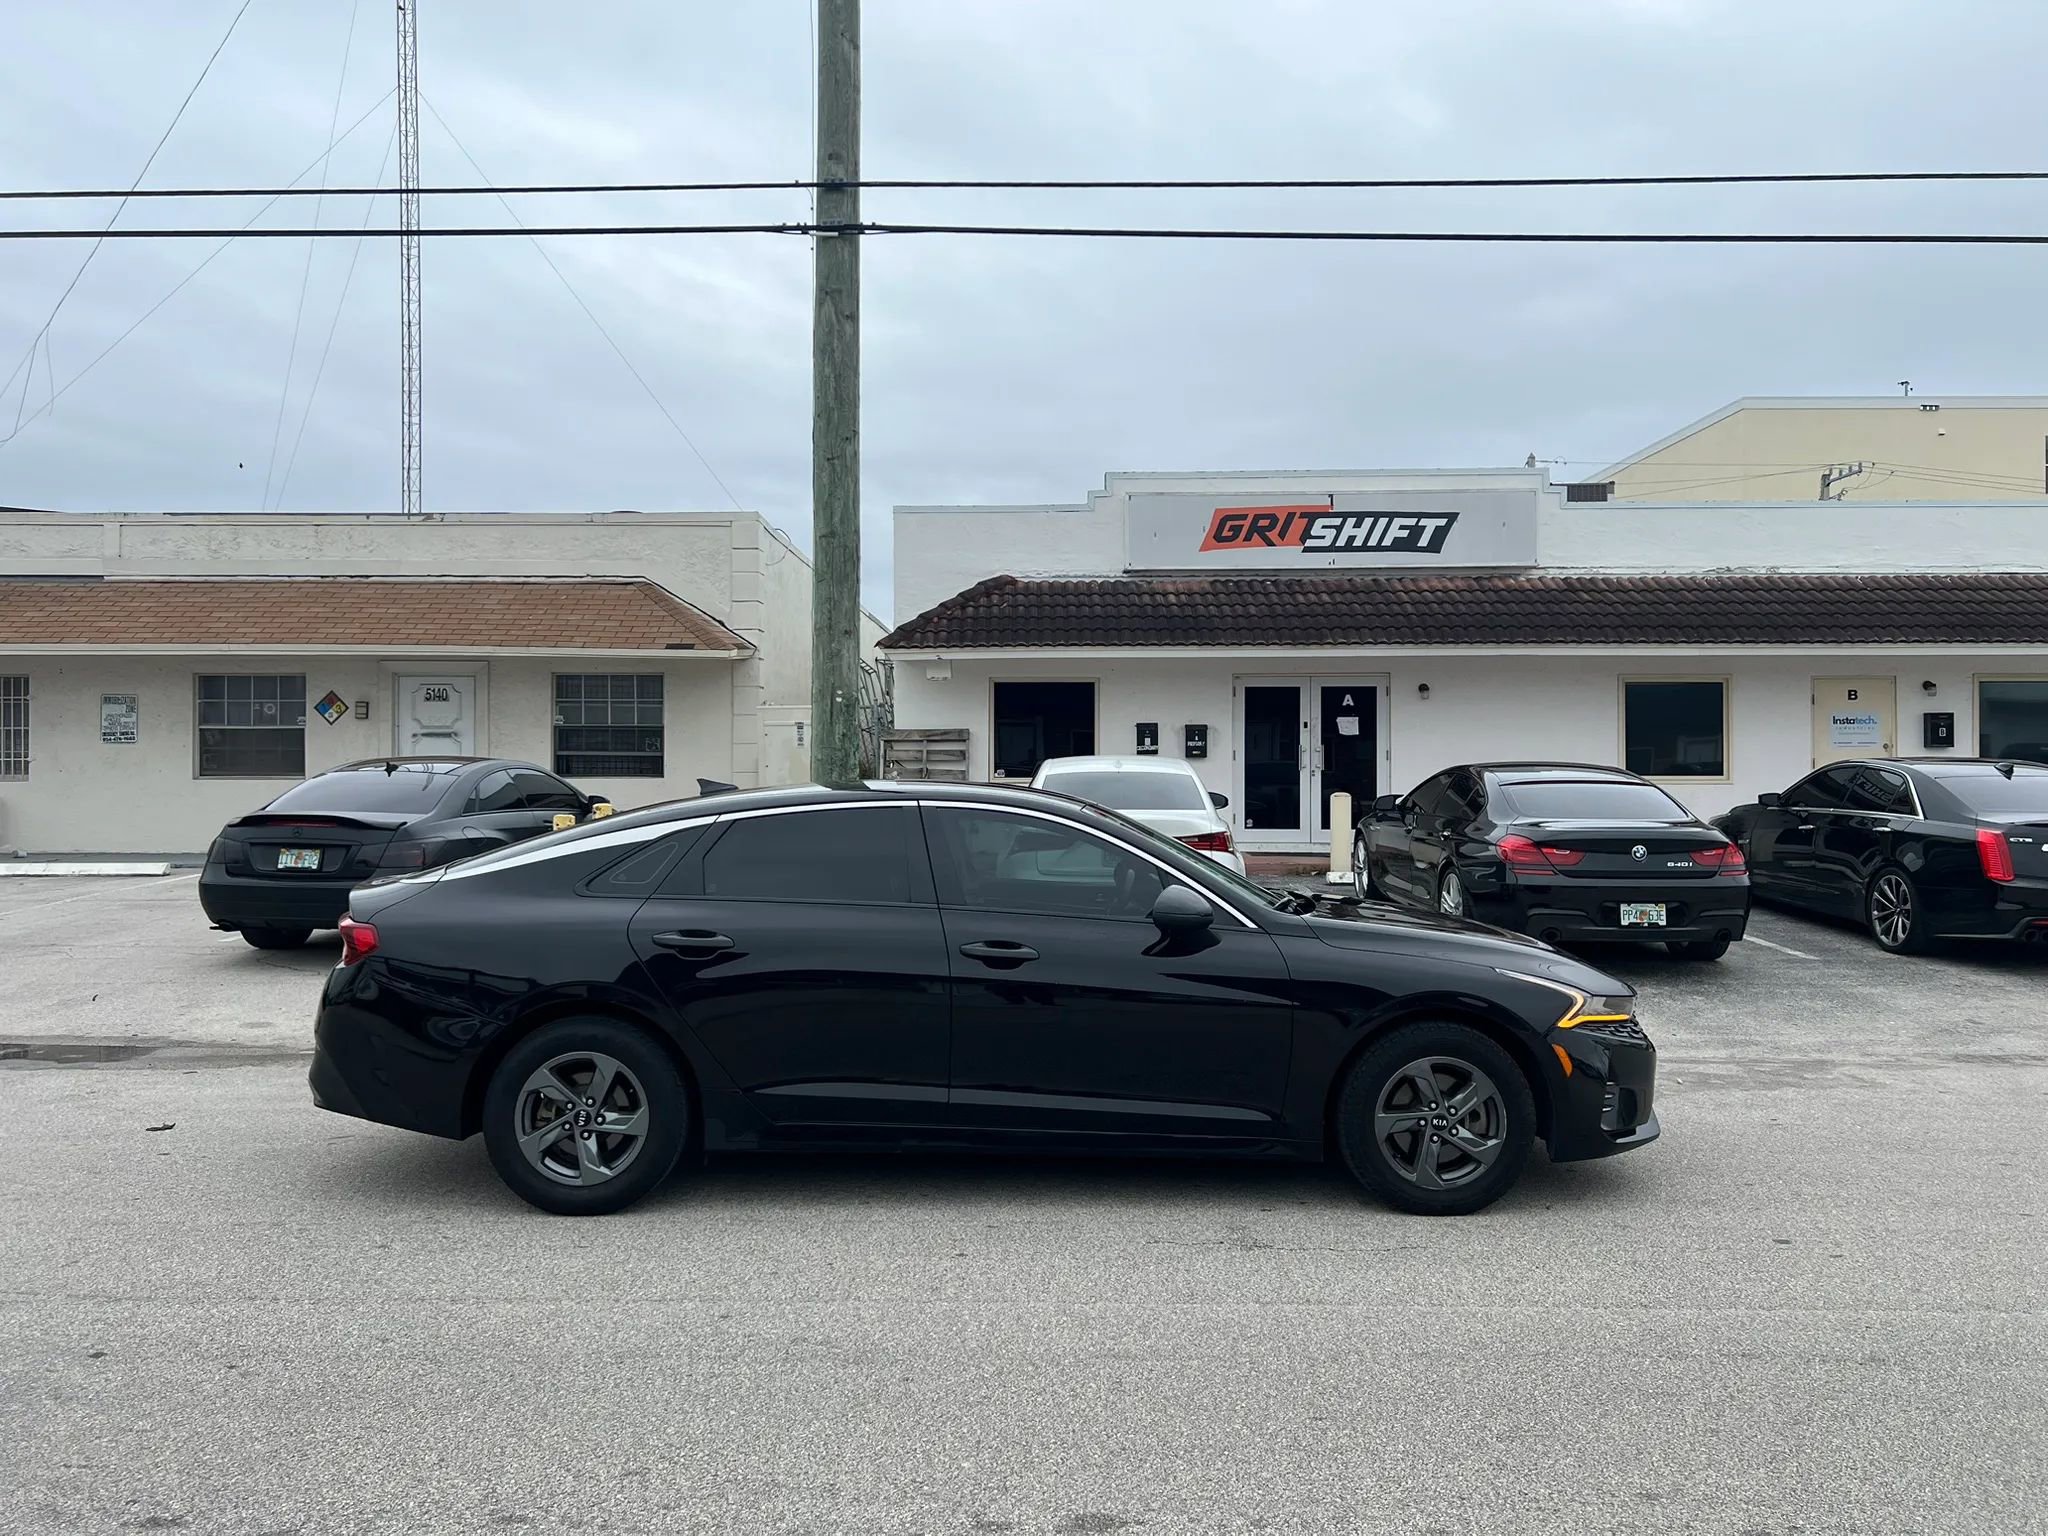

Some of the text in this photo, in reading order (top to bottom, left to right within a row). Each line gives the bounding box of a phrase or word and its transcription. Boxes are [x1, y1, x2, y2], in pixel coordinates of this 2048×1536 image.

[425, 688, 449, 701] 5140
[1342, 694, 1354, 706] A
[1848, 690, 1858, 700] B
[335, 704, 342, 713] 3
[578, 1110, 587, 1126] KIA
[1432, 1118, 1447, 1126] KIA
